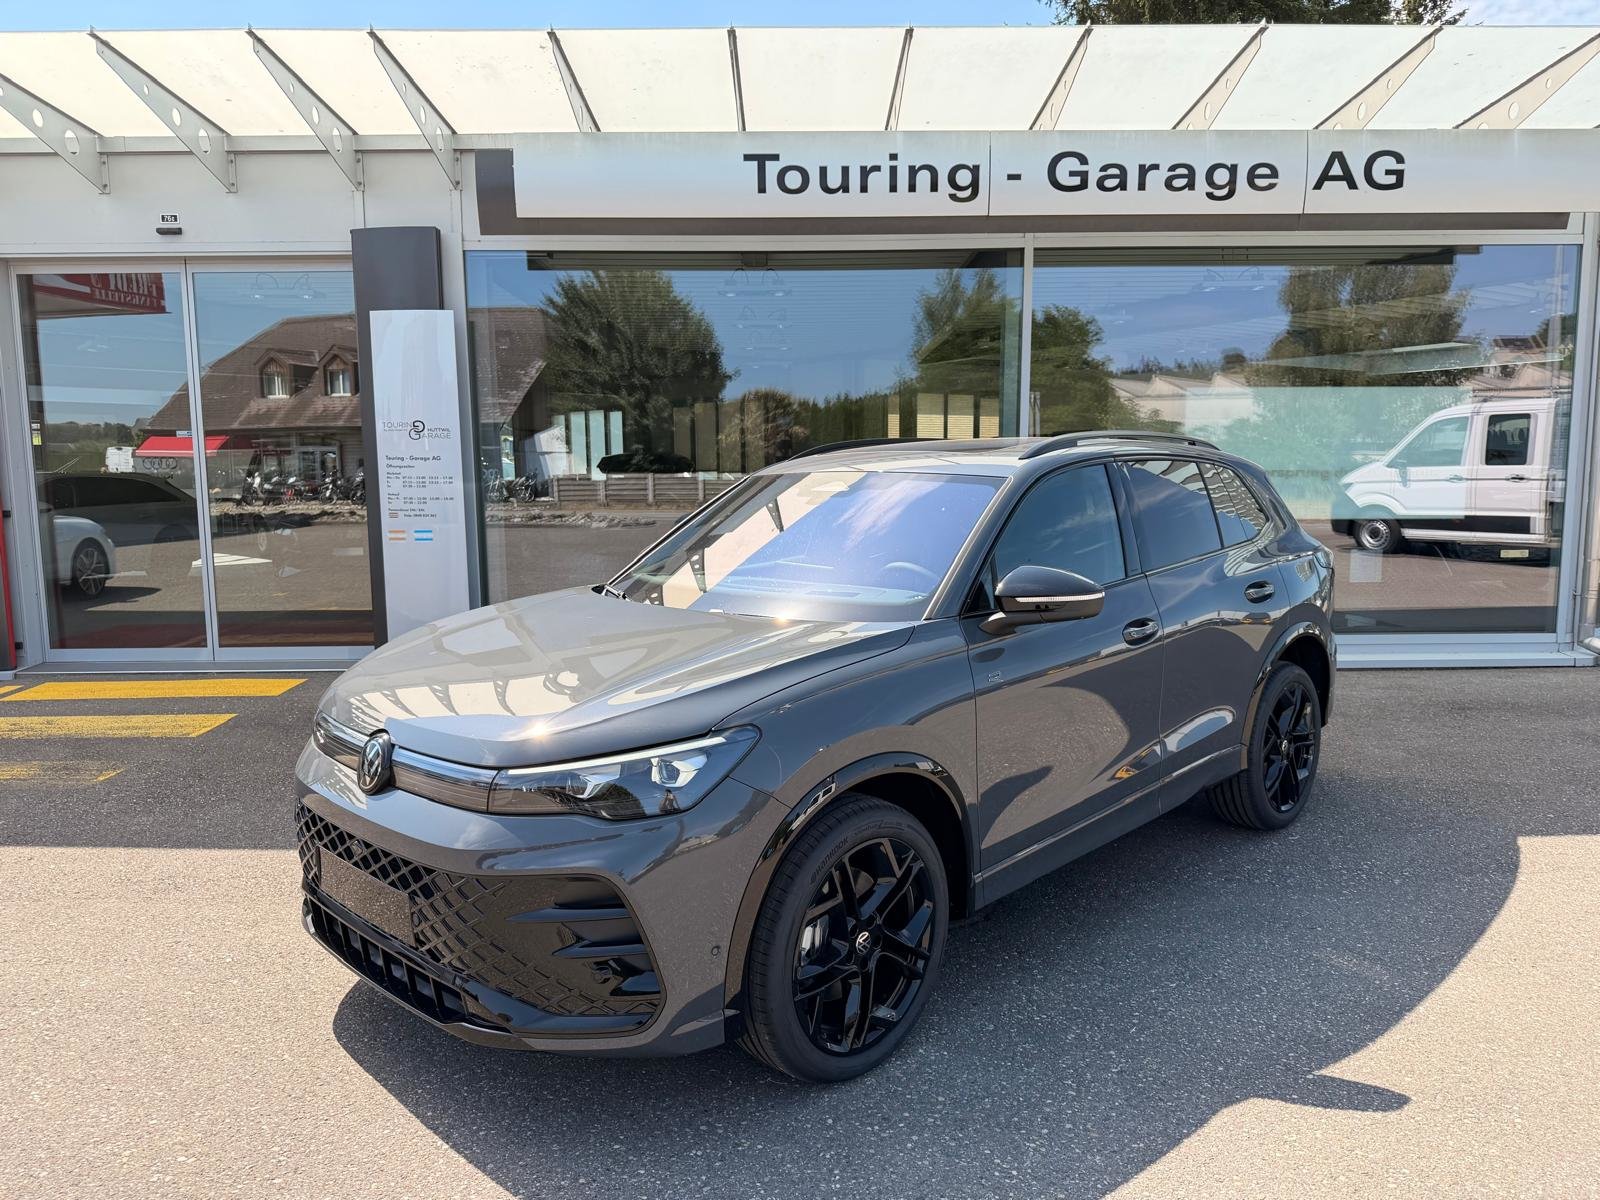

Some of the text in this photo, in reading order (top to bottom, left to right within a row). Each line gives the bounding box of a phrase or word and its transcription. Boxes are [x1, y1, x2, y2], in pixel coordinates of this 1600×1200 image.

[743, 150, 1405, 203] Touring - Garage AG
